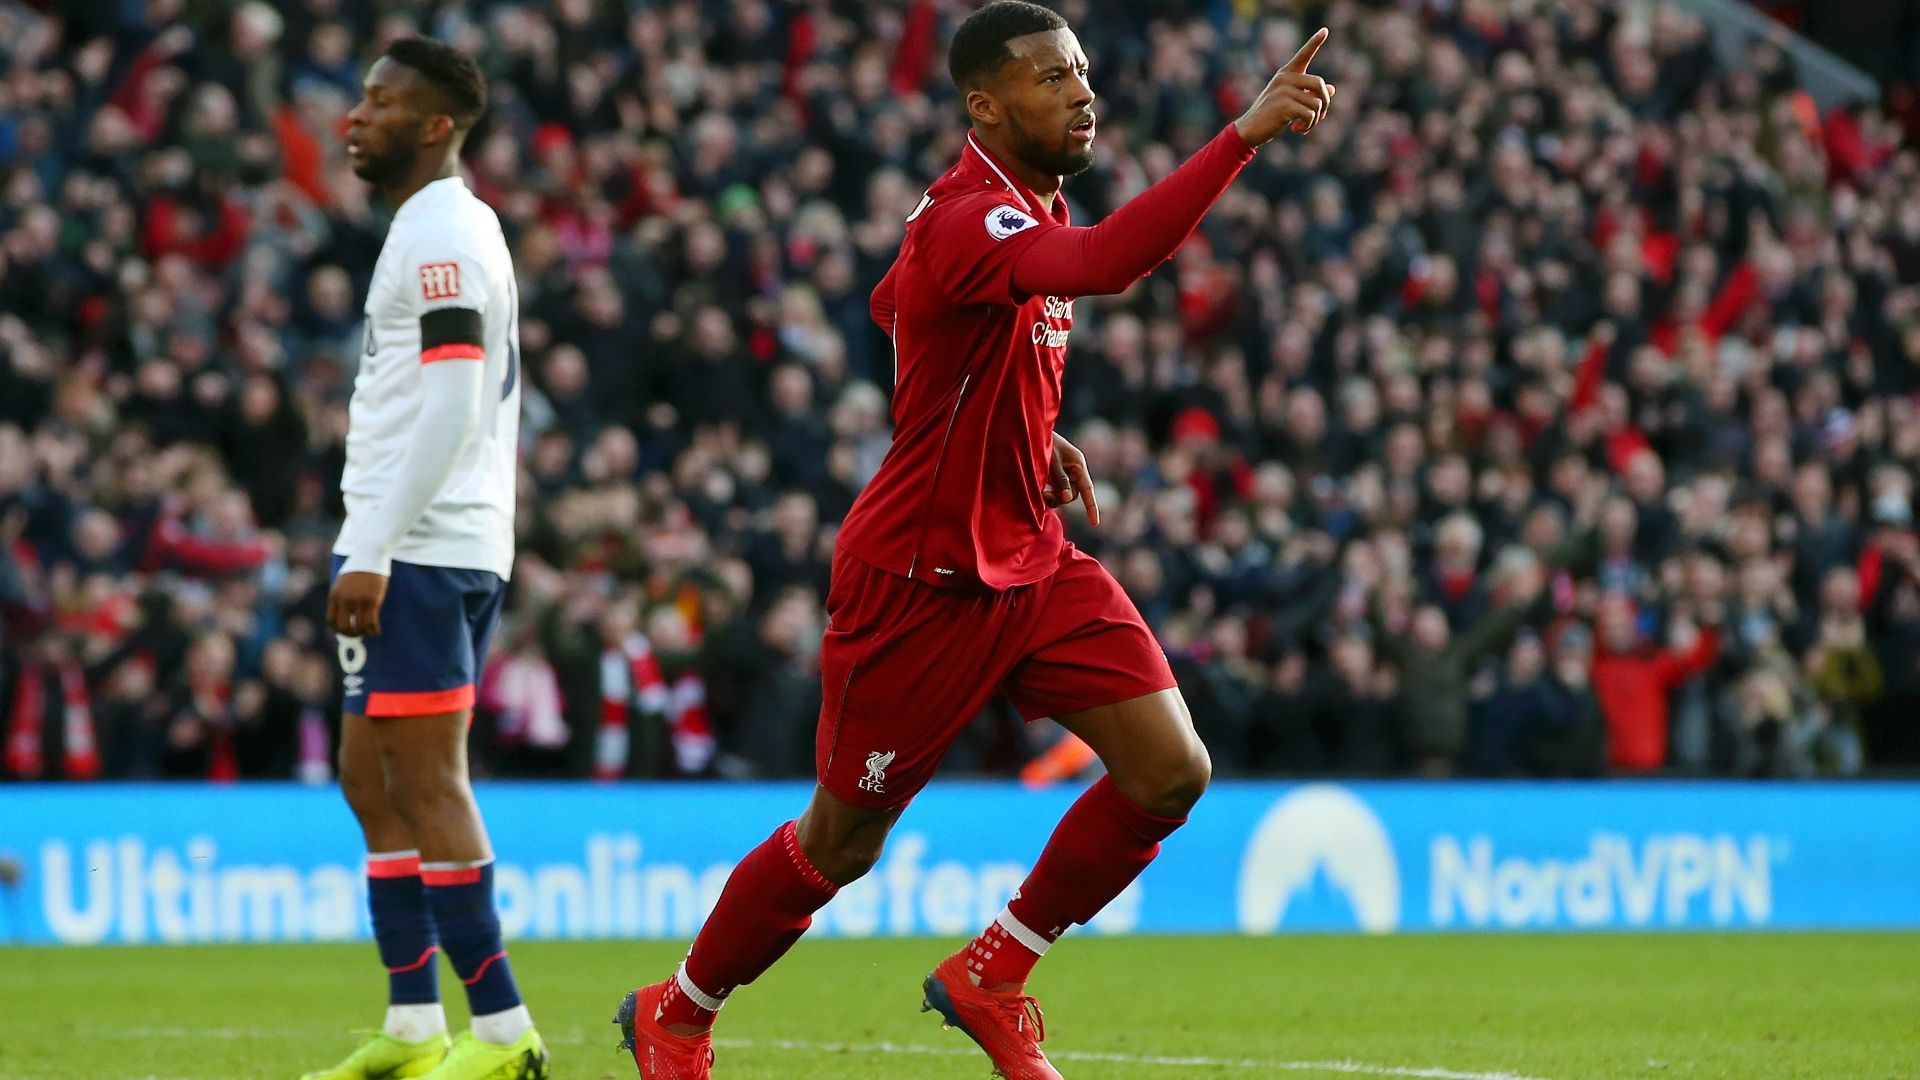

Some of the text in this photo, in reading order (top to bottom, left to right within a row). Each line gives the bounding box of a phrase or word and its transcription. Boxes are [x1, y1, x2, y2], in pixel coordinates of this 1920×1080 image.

[1043, 296, 1073, 320] Stan
[41, 833, 370, 942] Ultima
[806, 833, 1144, 938] efene
[1430, 830, 1772, 926] NordVPN
